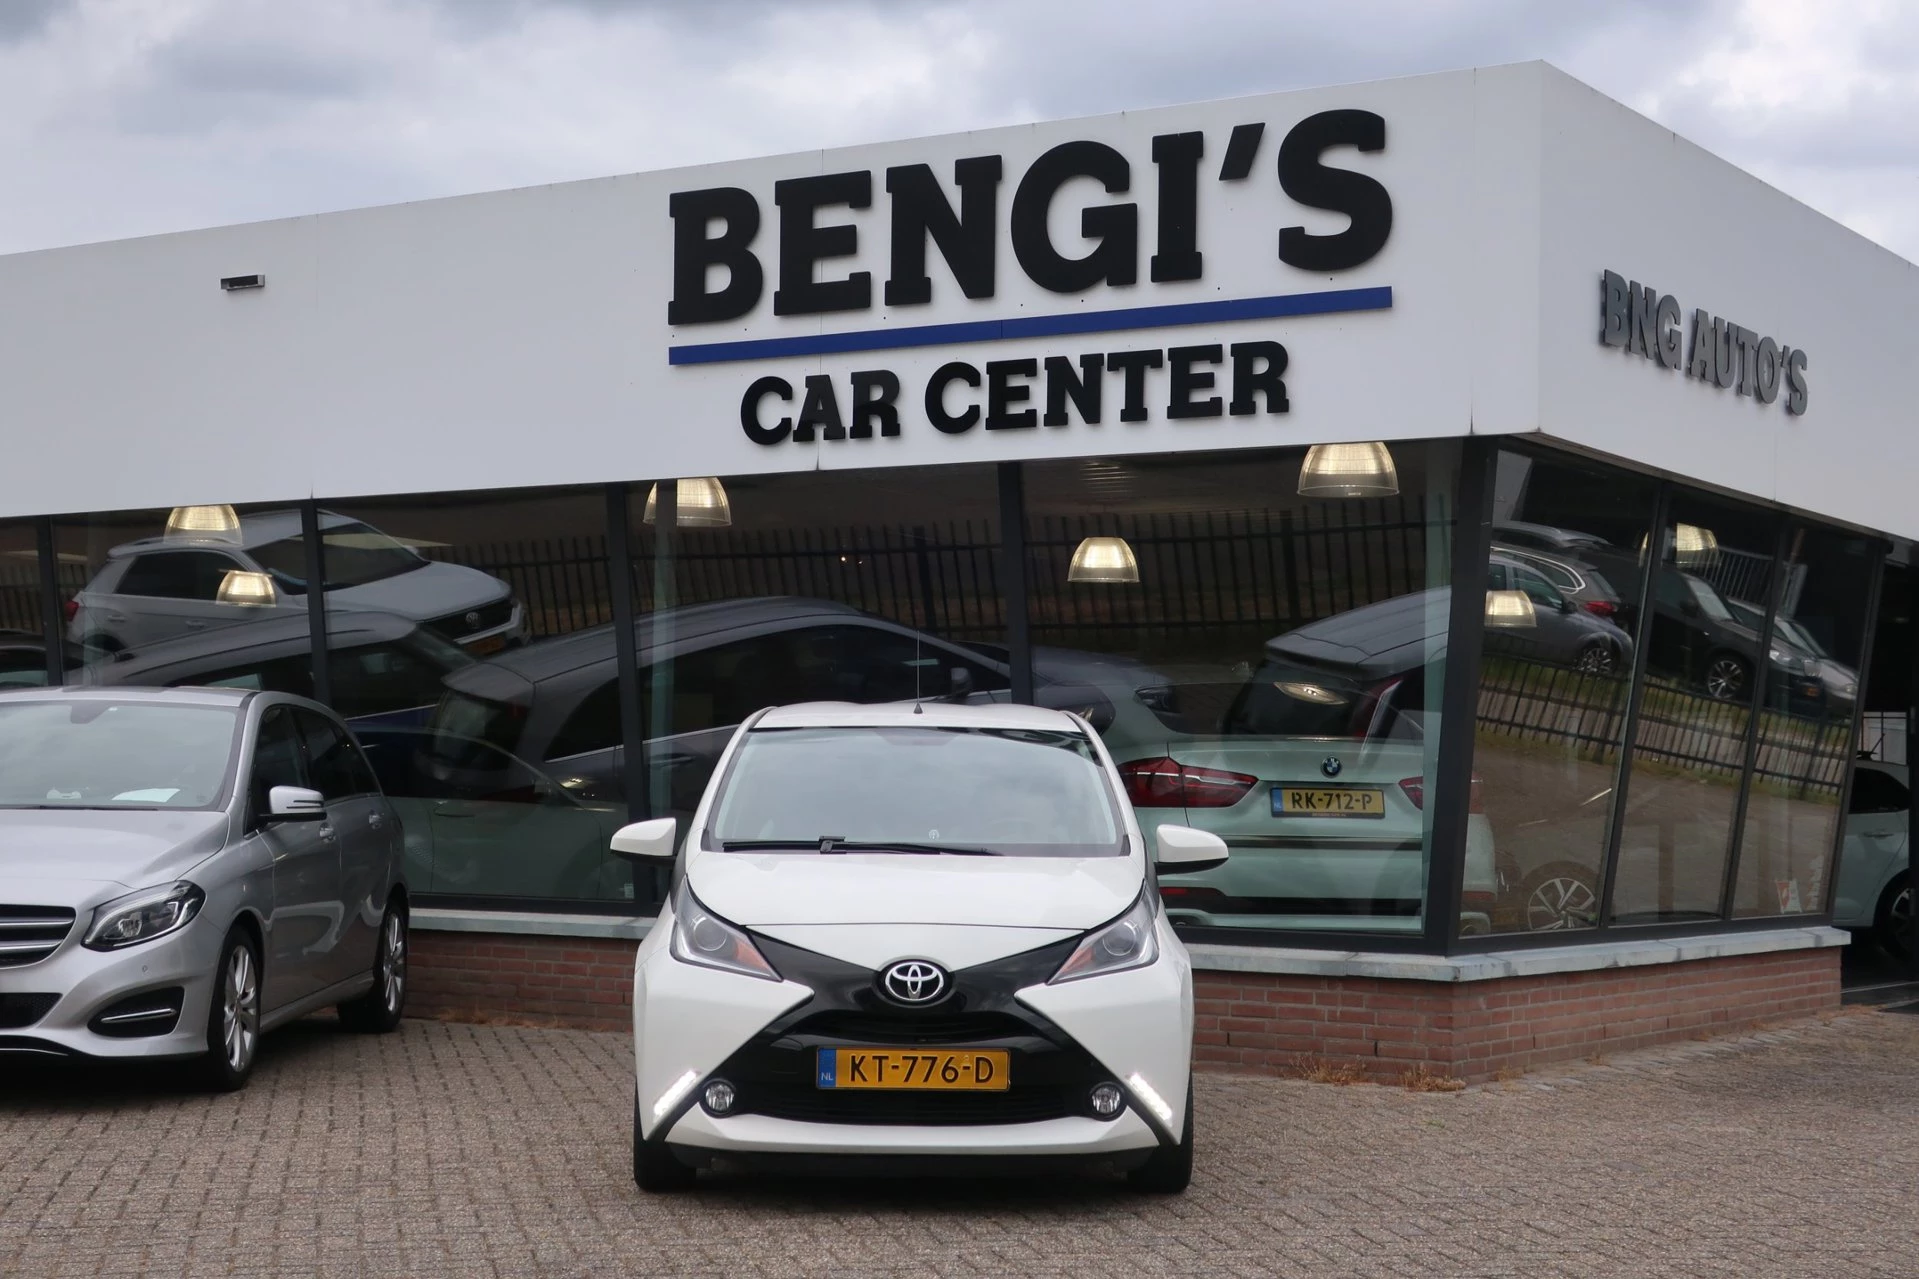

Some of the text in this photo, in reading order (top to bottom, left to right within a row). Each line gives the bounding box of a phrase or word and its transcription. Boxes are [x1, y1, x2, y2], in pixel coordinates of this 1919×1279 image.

[668, 109, 1393, 325] BENGI'S
[740, 340, 1289, 446] CAR CENTER
[1601, 269, 1808, 416] BNG AUTO'S
[1291, 792, 1373, 810] RK-712-P
[821, 1055, 994, 1083] NL KT-776-D
